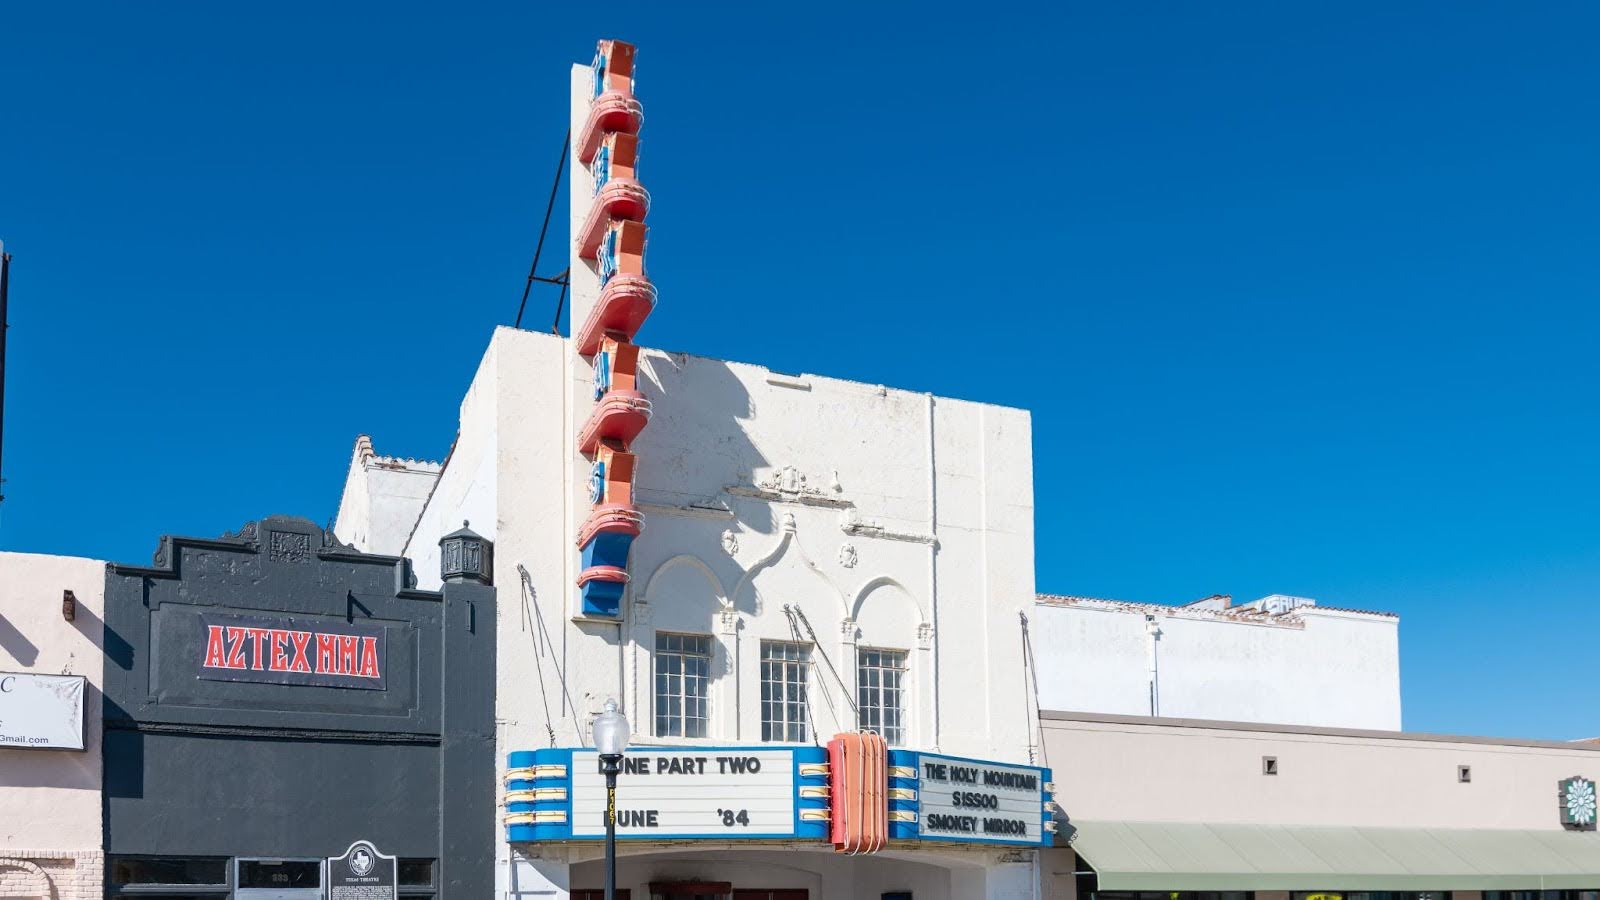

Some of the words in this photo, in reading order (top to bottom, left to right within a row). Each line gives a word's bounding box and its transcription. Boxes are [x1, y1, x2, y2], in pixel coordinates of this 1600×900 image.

[203, 625, 312, 673] AZTEX
[315, 632, 380, 678] MMA
[656, 757, 707, 774] PART
[716, 757, 761, 774] TWO
[925, 763, 946, 780] THE
[950, 766, 978, 783] HOLY
[984, 770, 1036, 789] MOUNTAIN
[927, 814, 977, 832] SMOKEY
[983, 817, 1026, 835] MIRROR
